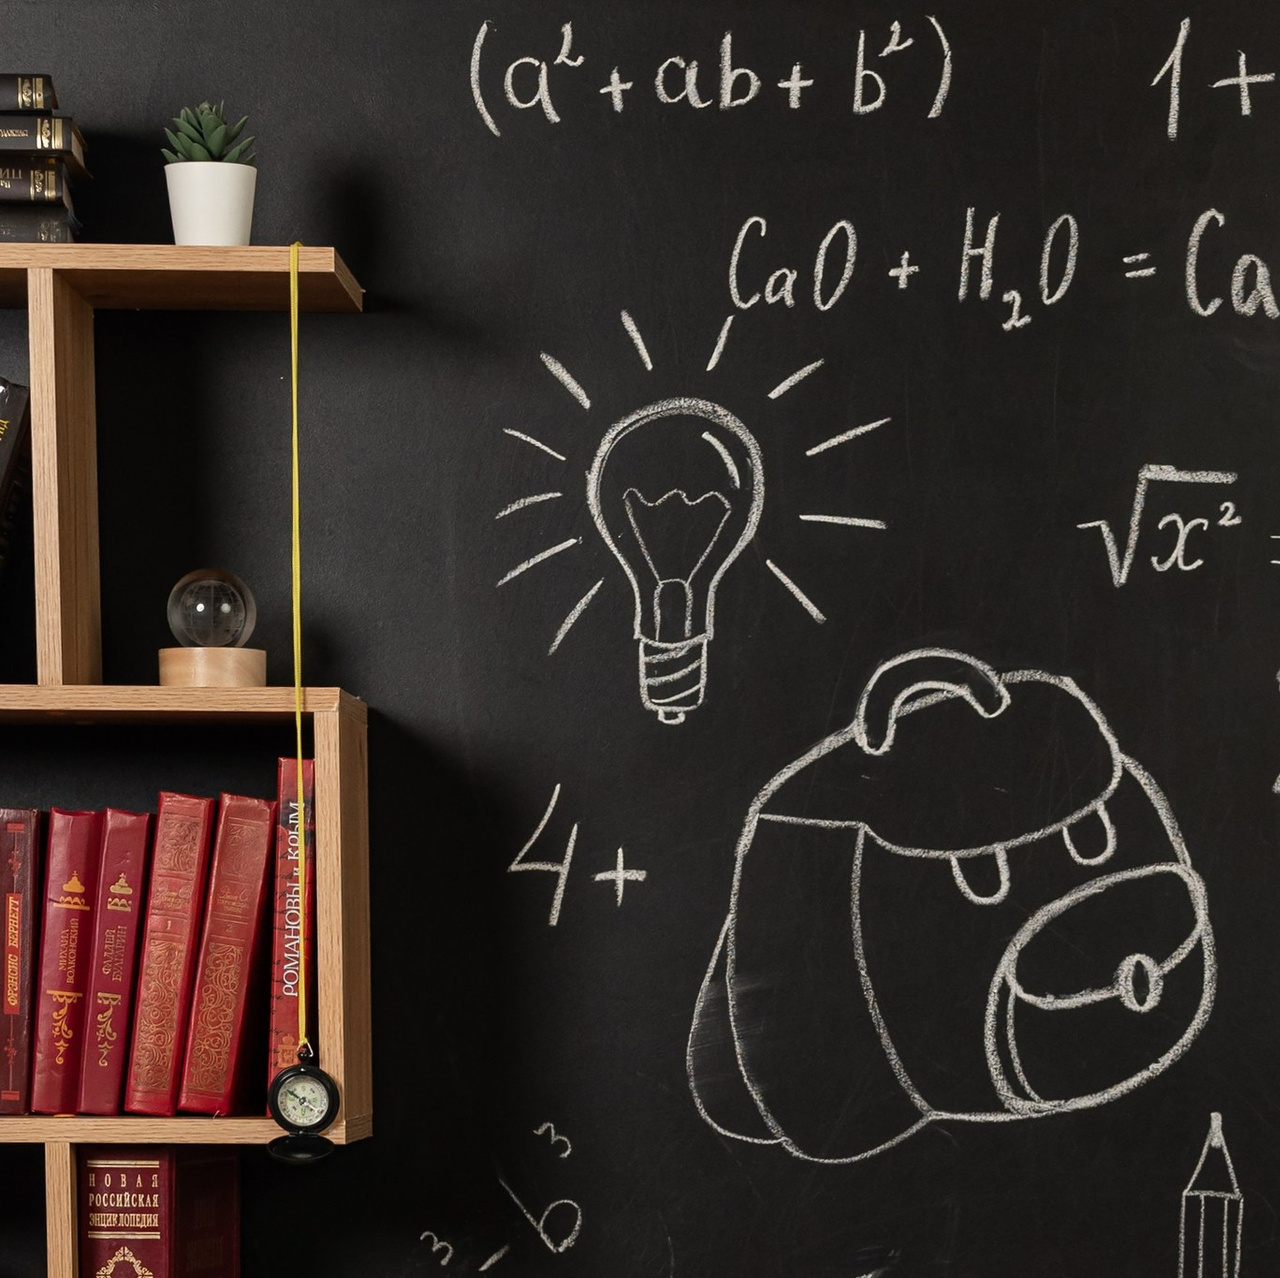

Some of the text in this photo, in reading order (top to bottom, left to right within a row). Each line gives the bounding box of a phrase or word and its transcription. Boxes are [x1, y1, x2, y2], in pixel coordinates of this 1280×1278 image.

[8, 896, 19, 1006] ФРЭНСИС БЕРНЕТТ
[59, 929, 69, 971] МИХАИЛ
[66, 917, 79, 985] ВОЛКОНСКИЙ
[102, 928, 115, 975] ФАДДЕЙ
[112, 925, 127, 982] БУЛГАРИН
[89, 1173, 158, 1187] НОВАЯ
[89, 1191, 159, 1207] РОССИЙСКАЯ
[89, 1213, 159, 1228] ЭНЦИКЛОПЕДИЯ
